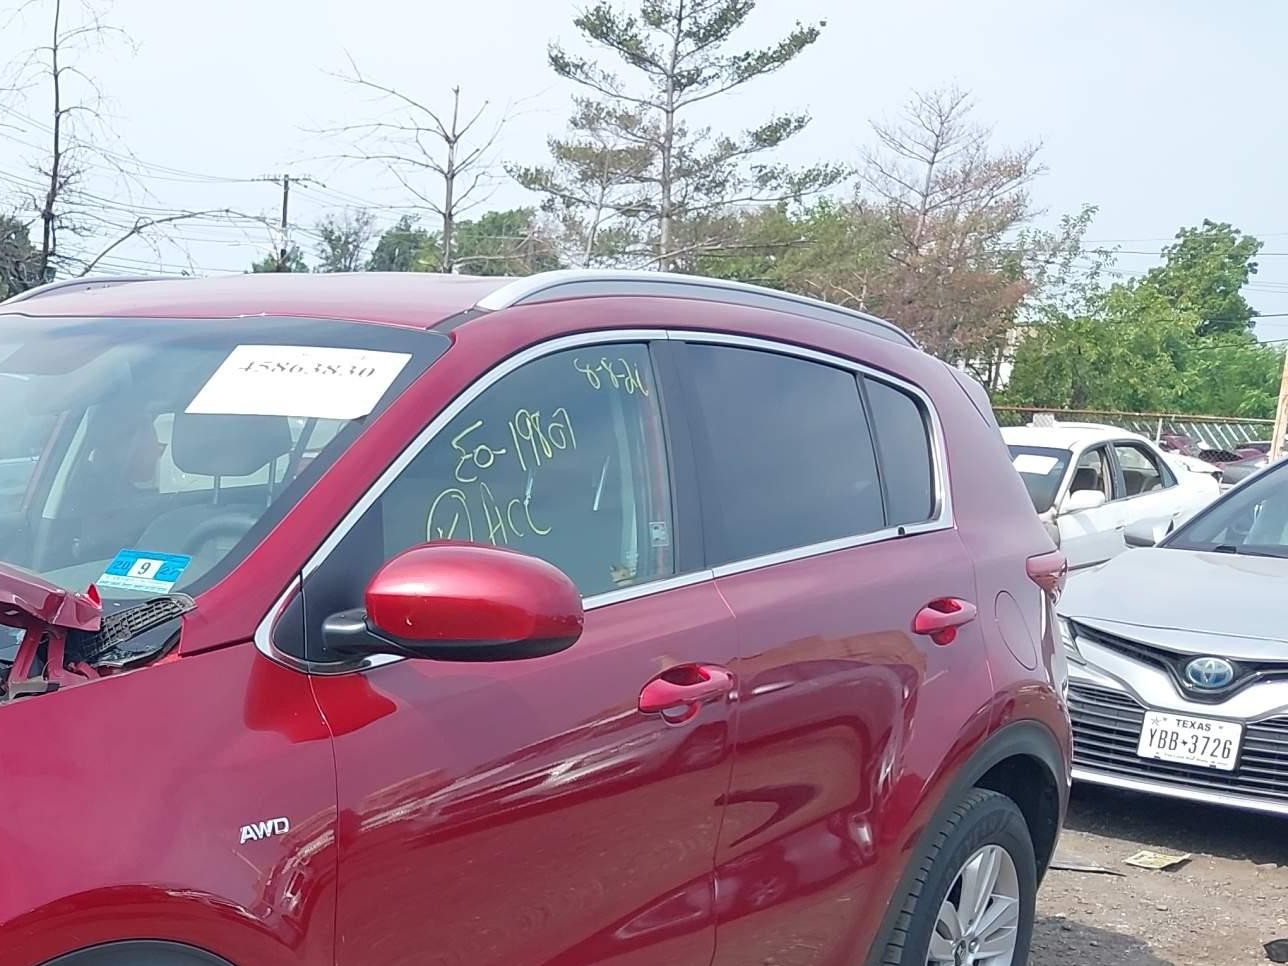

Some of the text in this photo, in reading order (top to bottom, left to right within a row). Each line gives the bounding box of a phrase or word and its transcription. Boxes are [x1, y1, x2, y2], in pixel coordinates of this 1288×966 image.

[137, 561, 152, 575] 9
[1175, 718, 1212, 732] TEXAS
[239, 816, 291, 845] AWD
